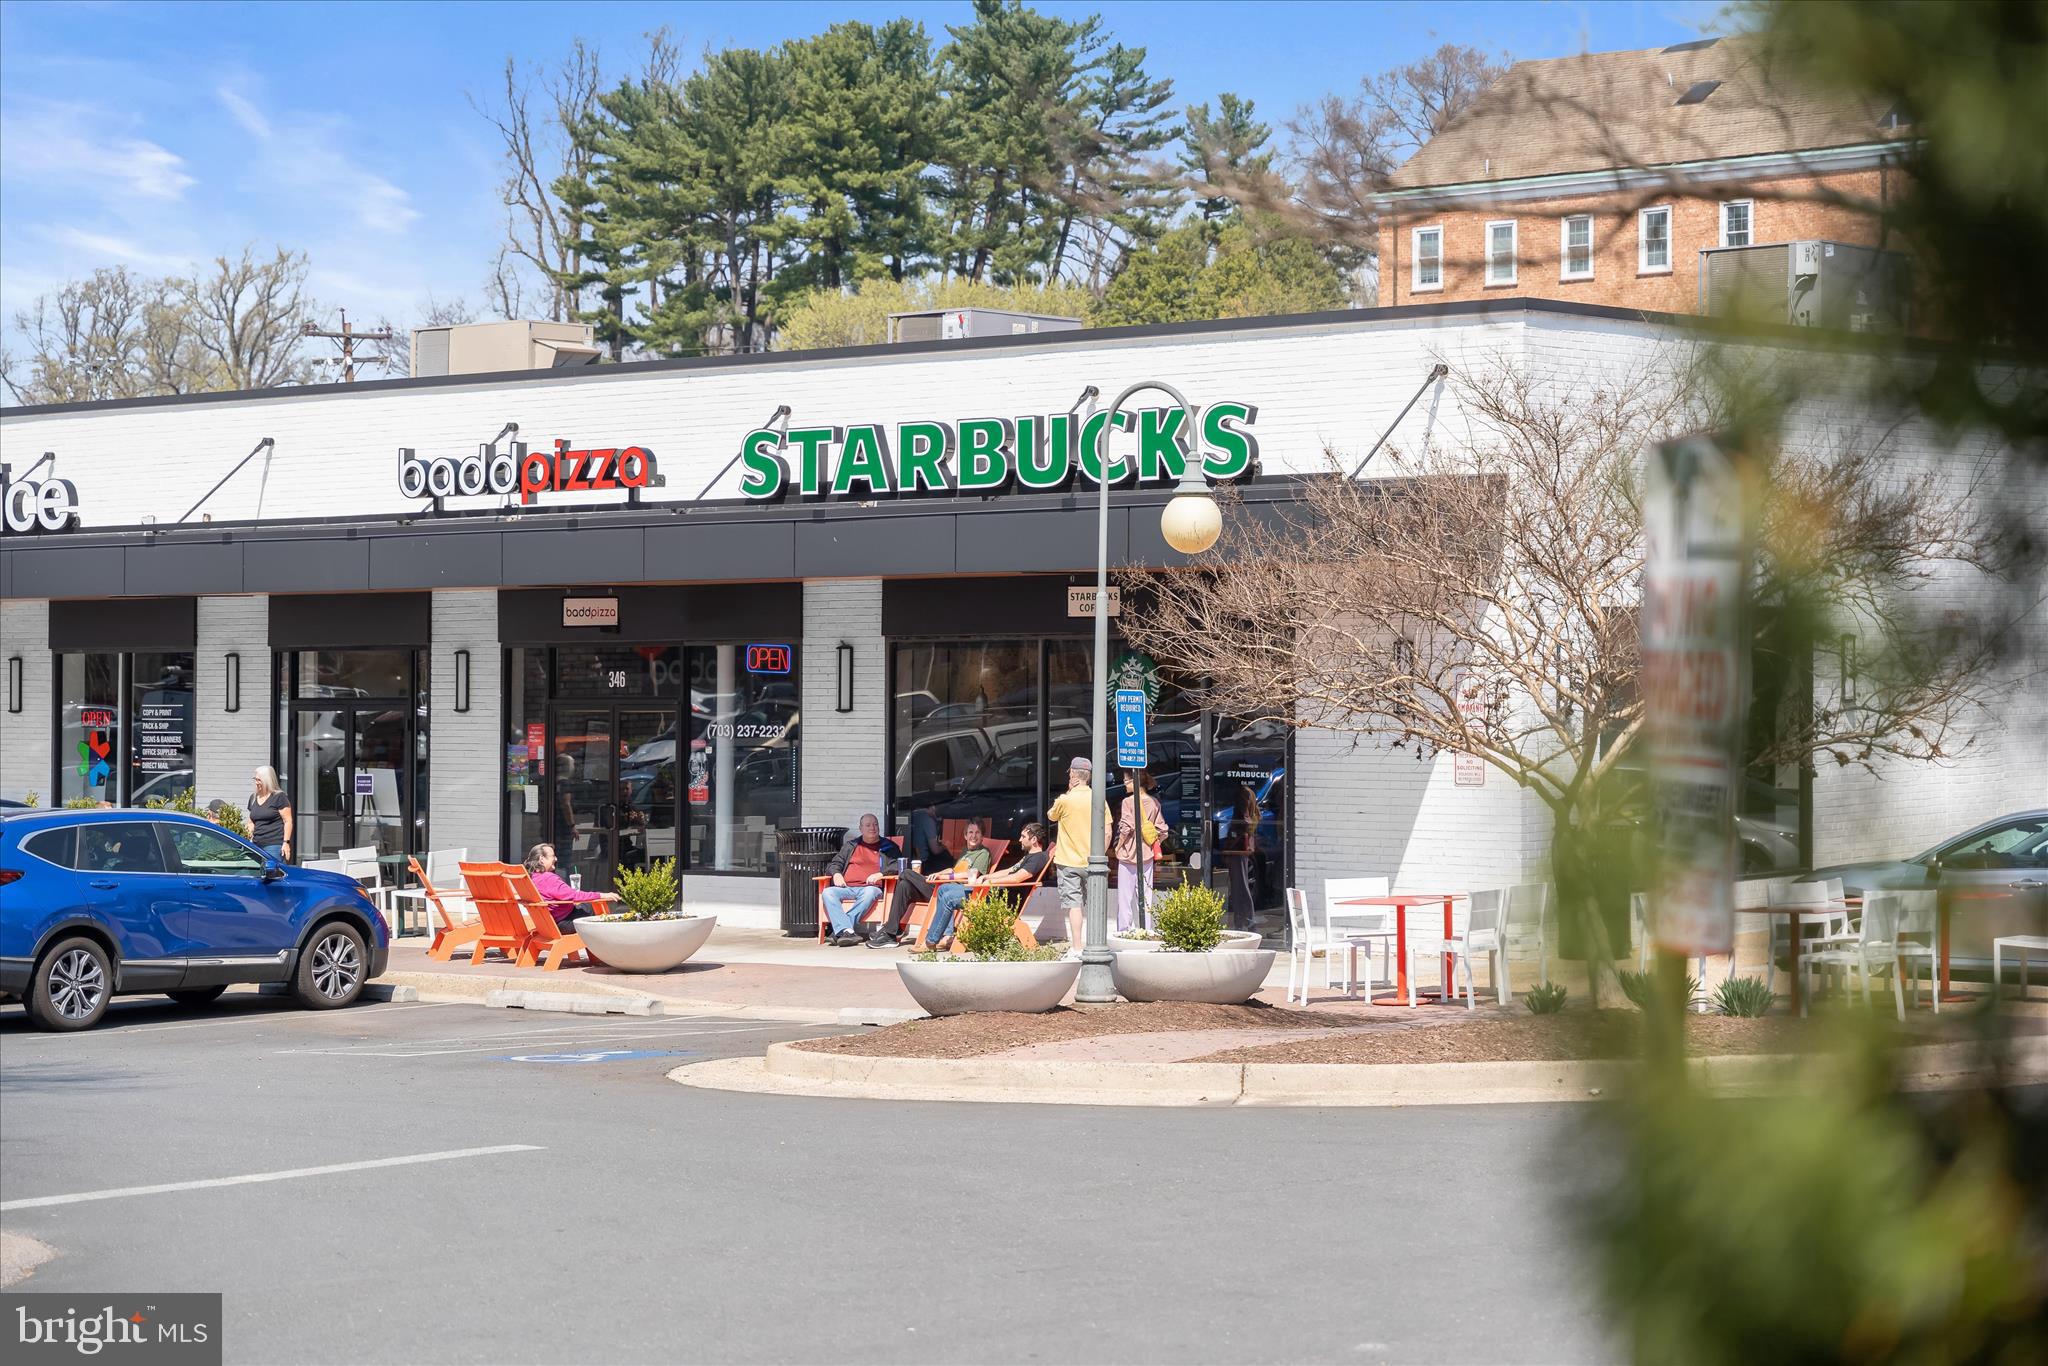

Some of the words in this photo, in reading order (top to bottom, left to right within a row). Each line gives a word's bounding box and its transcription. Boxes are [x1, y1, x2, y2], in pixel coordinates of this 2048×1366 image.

[740, 401, 1257, 499] STARBUCKS
[398, 439, 657, 505] baddpizza
[1070, 592, 1119, 600] STARBKS
[566, 607, 616, 619] baddpizza
[749, 647, 788, 670] OPEN
[608, 671, 626, 688] 346
[82, 711, 112, 727] OPEN
[142, 709, 155, 717] COPY
[159, 709, 172, 717] PRINT
[707, 723, 735, 740] (703)
[736, 724, 786, 738] 237-2233
[160, 736, 182, 744] BANNERS
[1226, 770, 1270, 778] STARBUCKS
